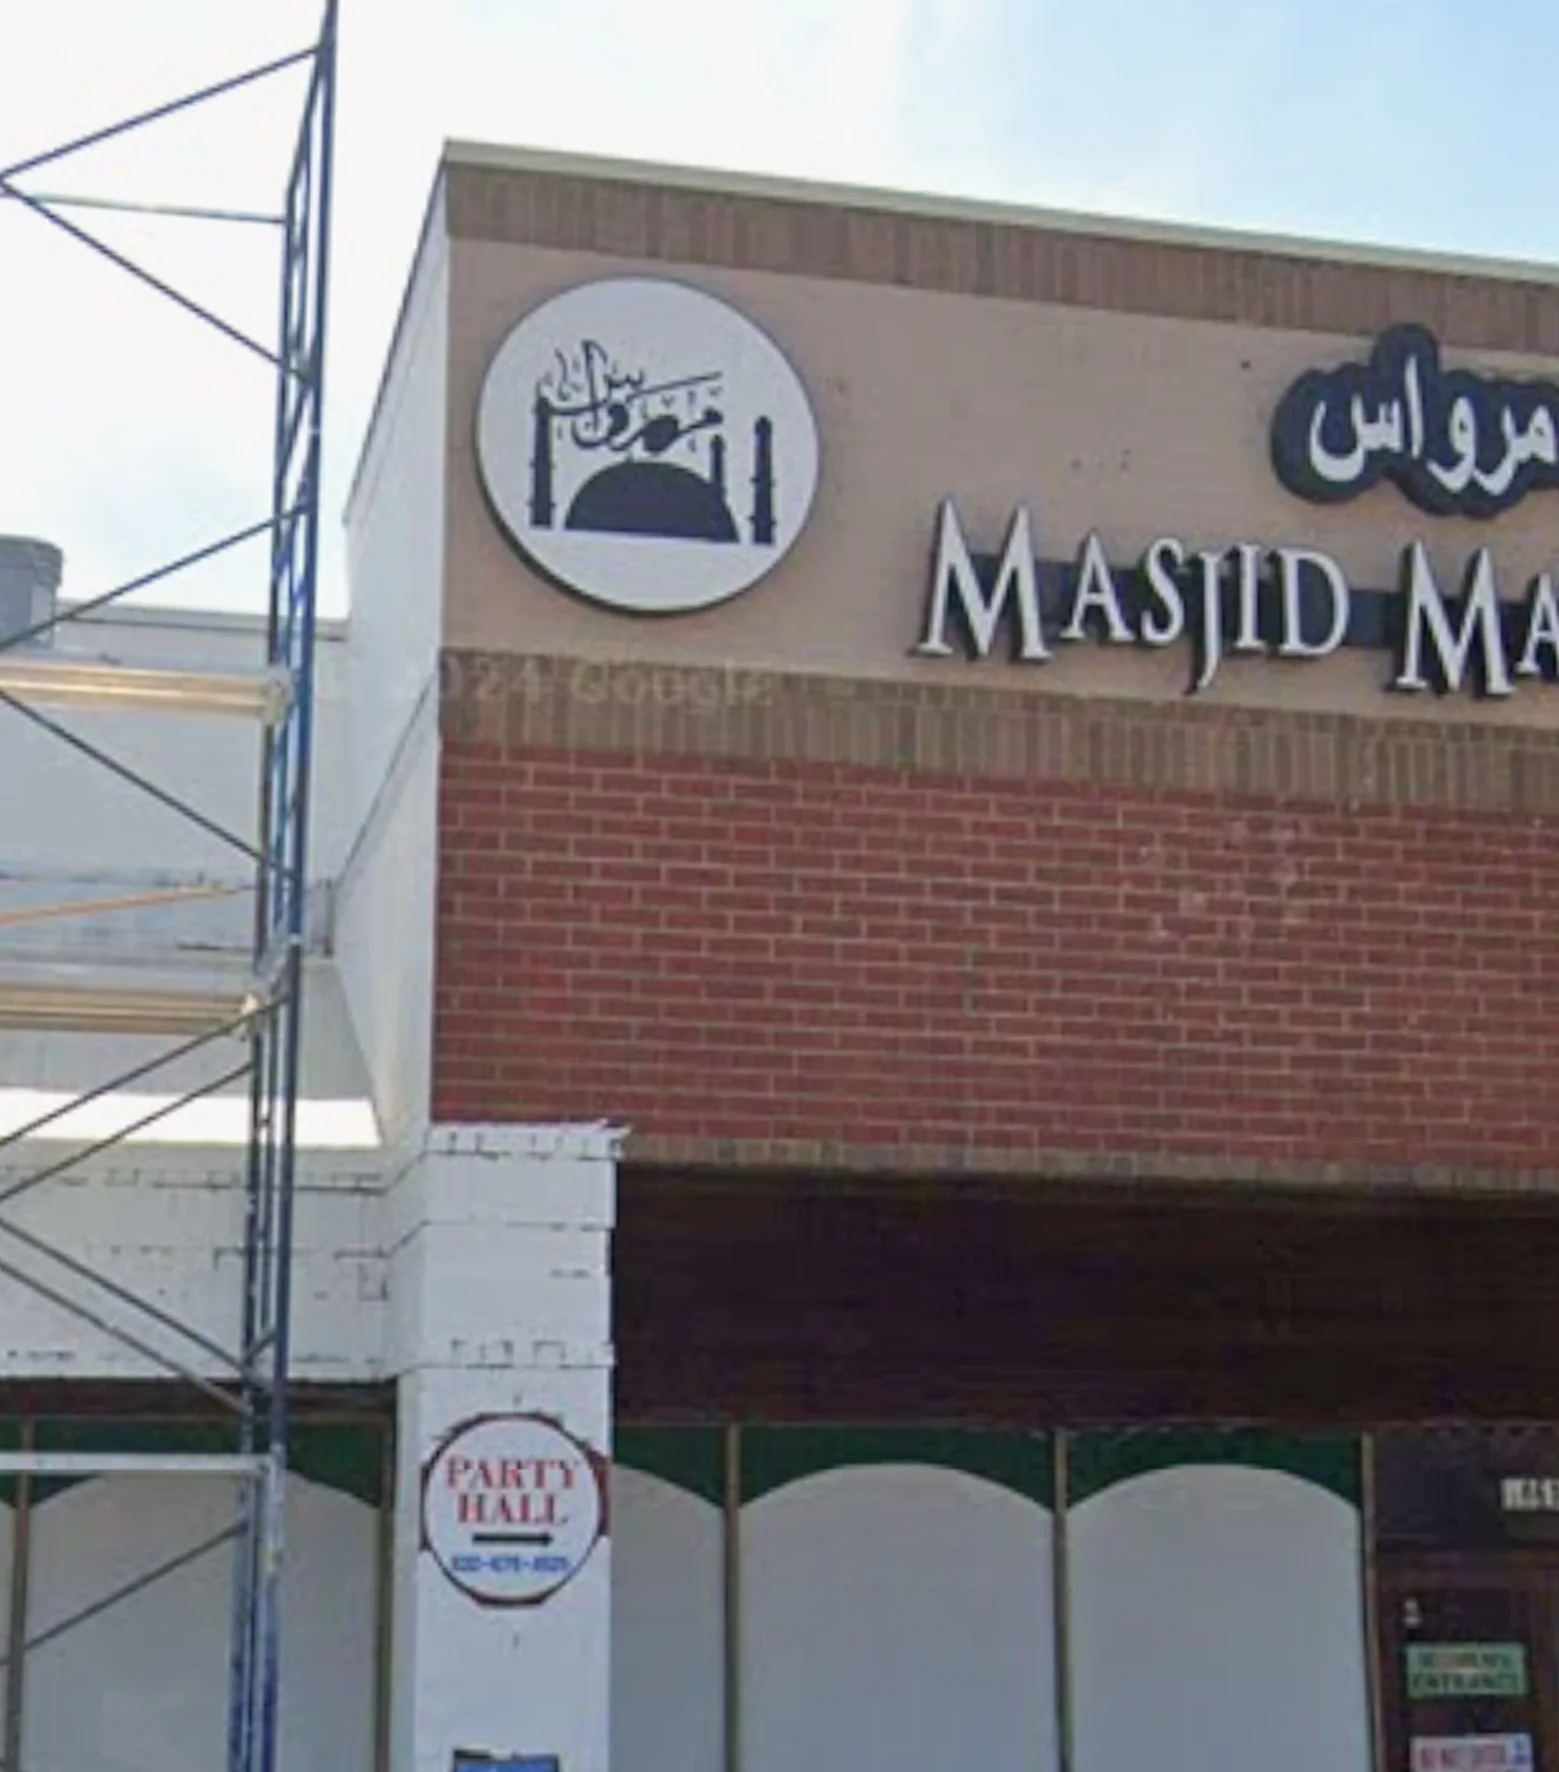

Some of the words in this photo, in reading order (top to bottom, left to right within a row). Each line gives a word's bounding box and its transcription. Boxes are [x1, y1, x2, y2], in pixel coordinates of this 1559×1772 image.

[912, 496, 1350, 692] MASJID
[445, 1457, 581, 1491] PARTY
[457, 1492, 571, 1526] HALL
